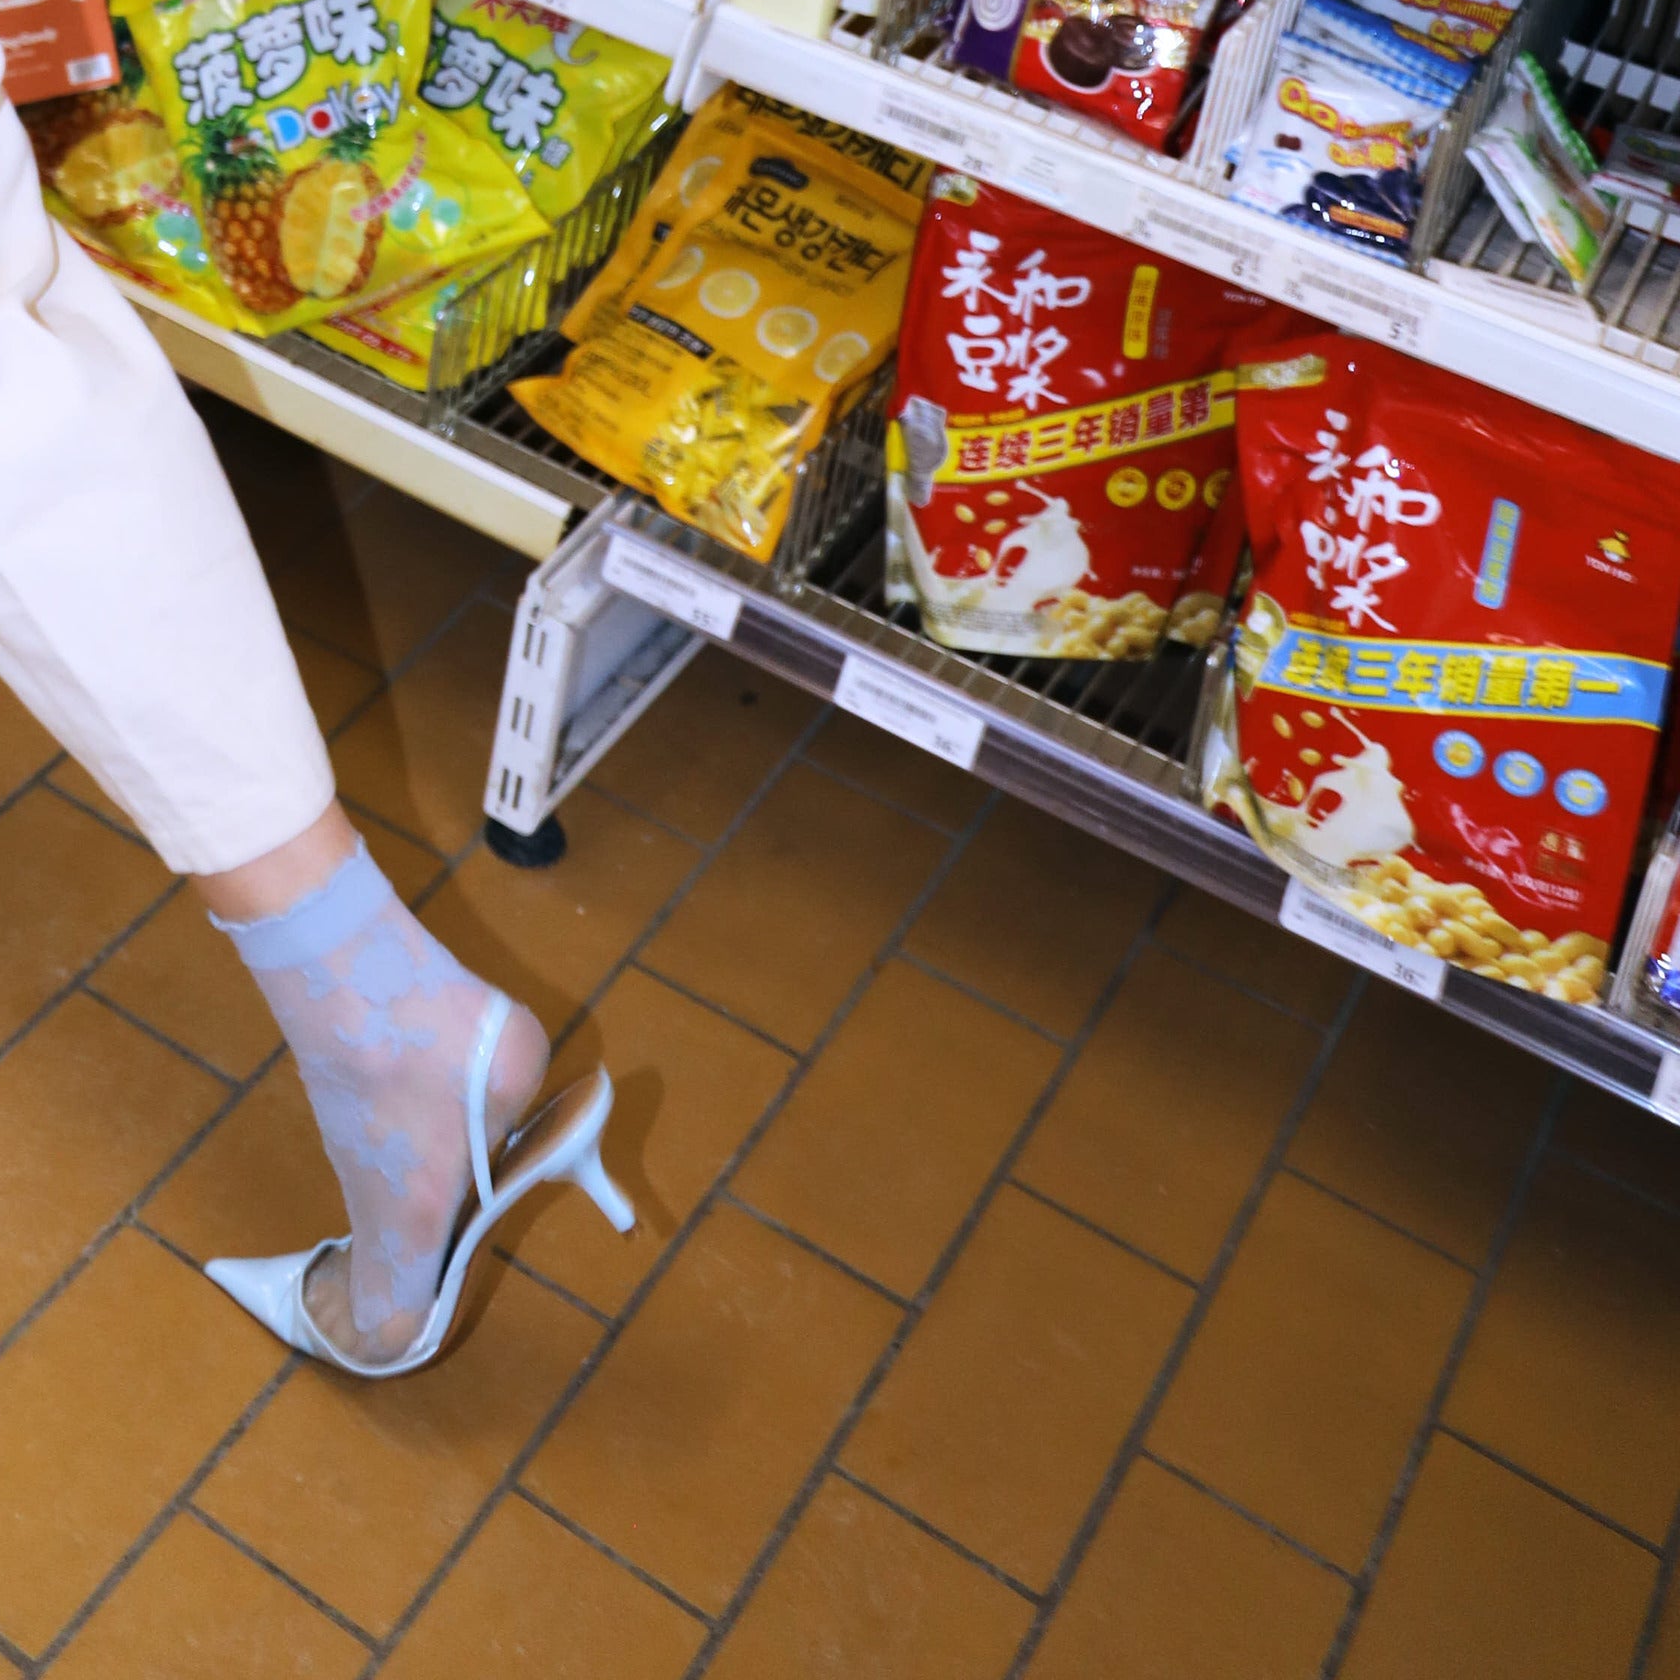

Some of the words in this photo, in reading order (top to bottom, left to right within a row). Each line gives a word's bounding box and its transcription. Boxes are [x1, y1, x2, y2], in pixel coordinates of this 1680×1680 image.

[420, 16, 566, 151] 萝味
[1278, 77, 1340, 132] QQ
[941, 230, 1092, 326] 永和
[946, 315, 1070, 412] 豆浆
[957, 382, 1236, 474] 连续三年销量第一
[1280, 639, 1622, 713] 连续三年销量第一
